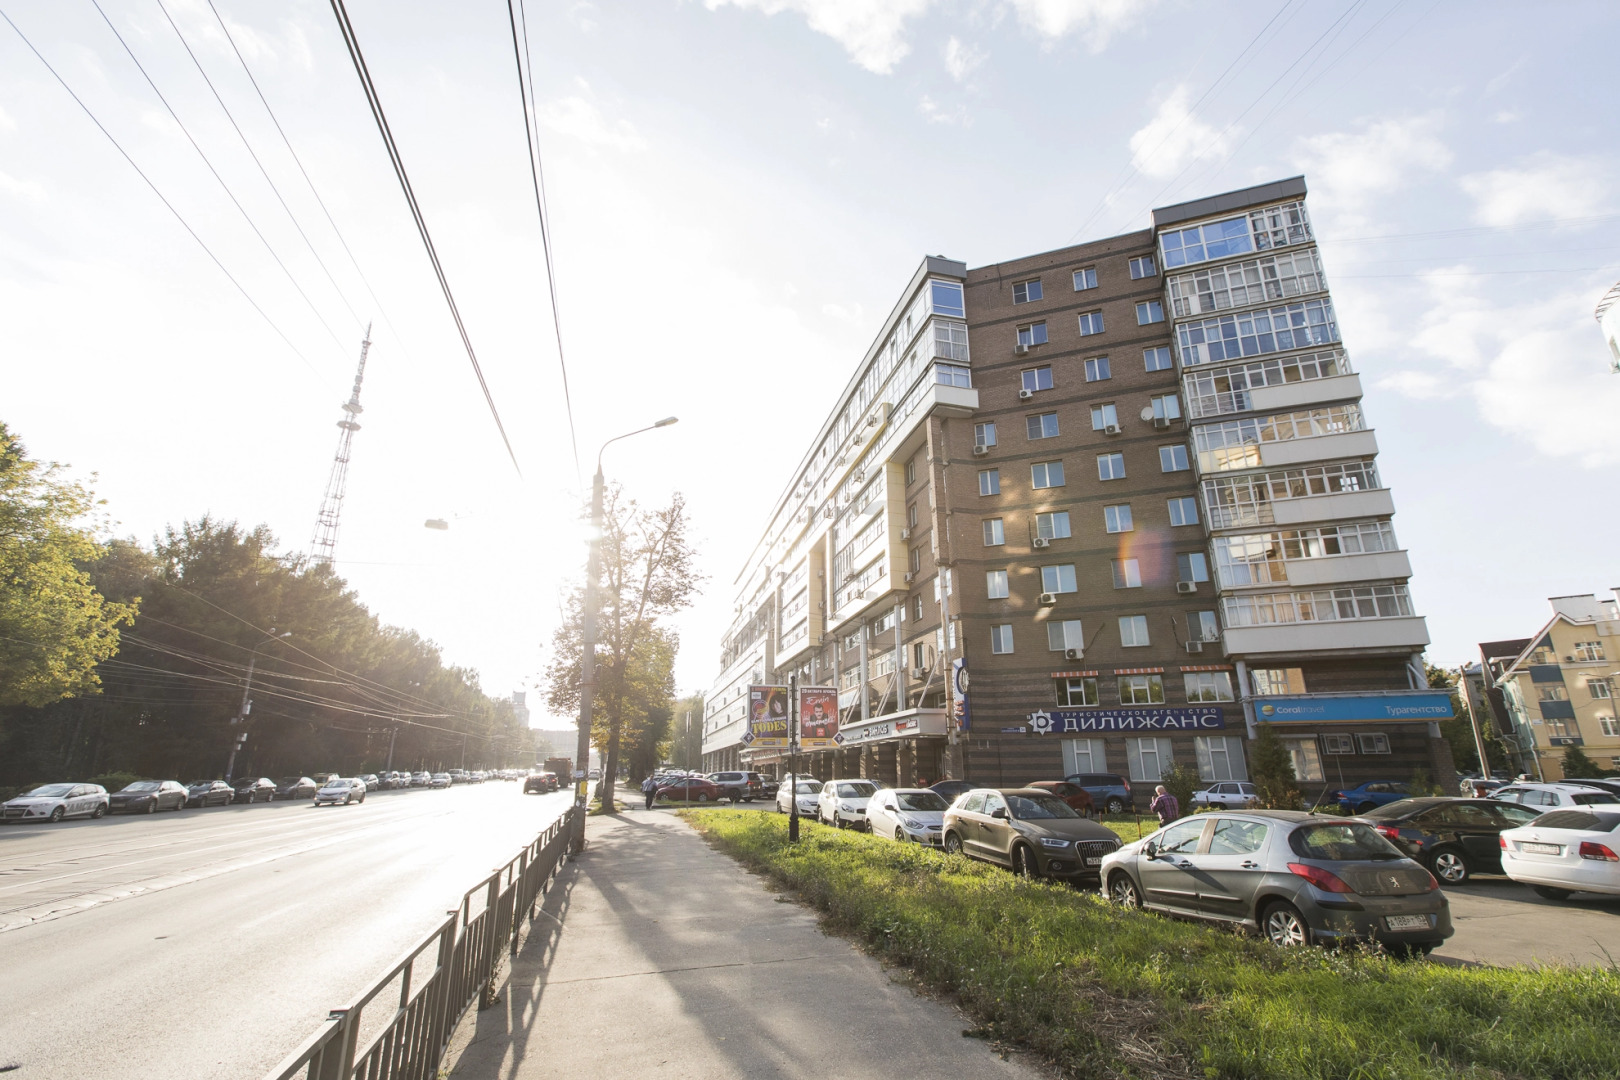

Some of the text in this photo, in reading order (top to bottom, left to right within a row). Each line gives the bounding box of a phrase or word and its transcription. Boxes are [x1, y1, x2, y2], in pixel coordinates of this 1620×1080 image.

[1060, 710, 1147, 718] ТУРИСТИЧЕСКОЕ
[1384, 705, 1447, 716] Турагентство
[751, 719, 788, 734] TODES
[1063, 715, 1219, 732] ДИЛИЖАНС
